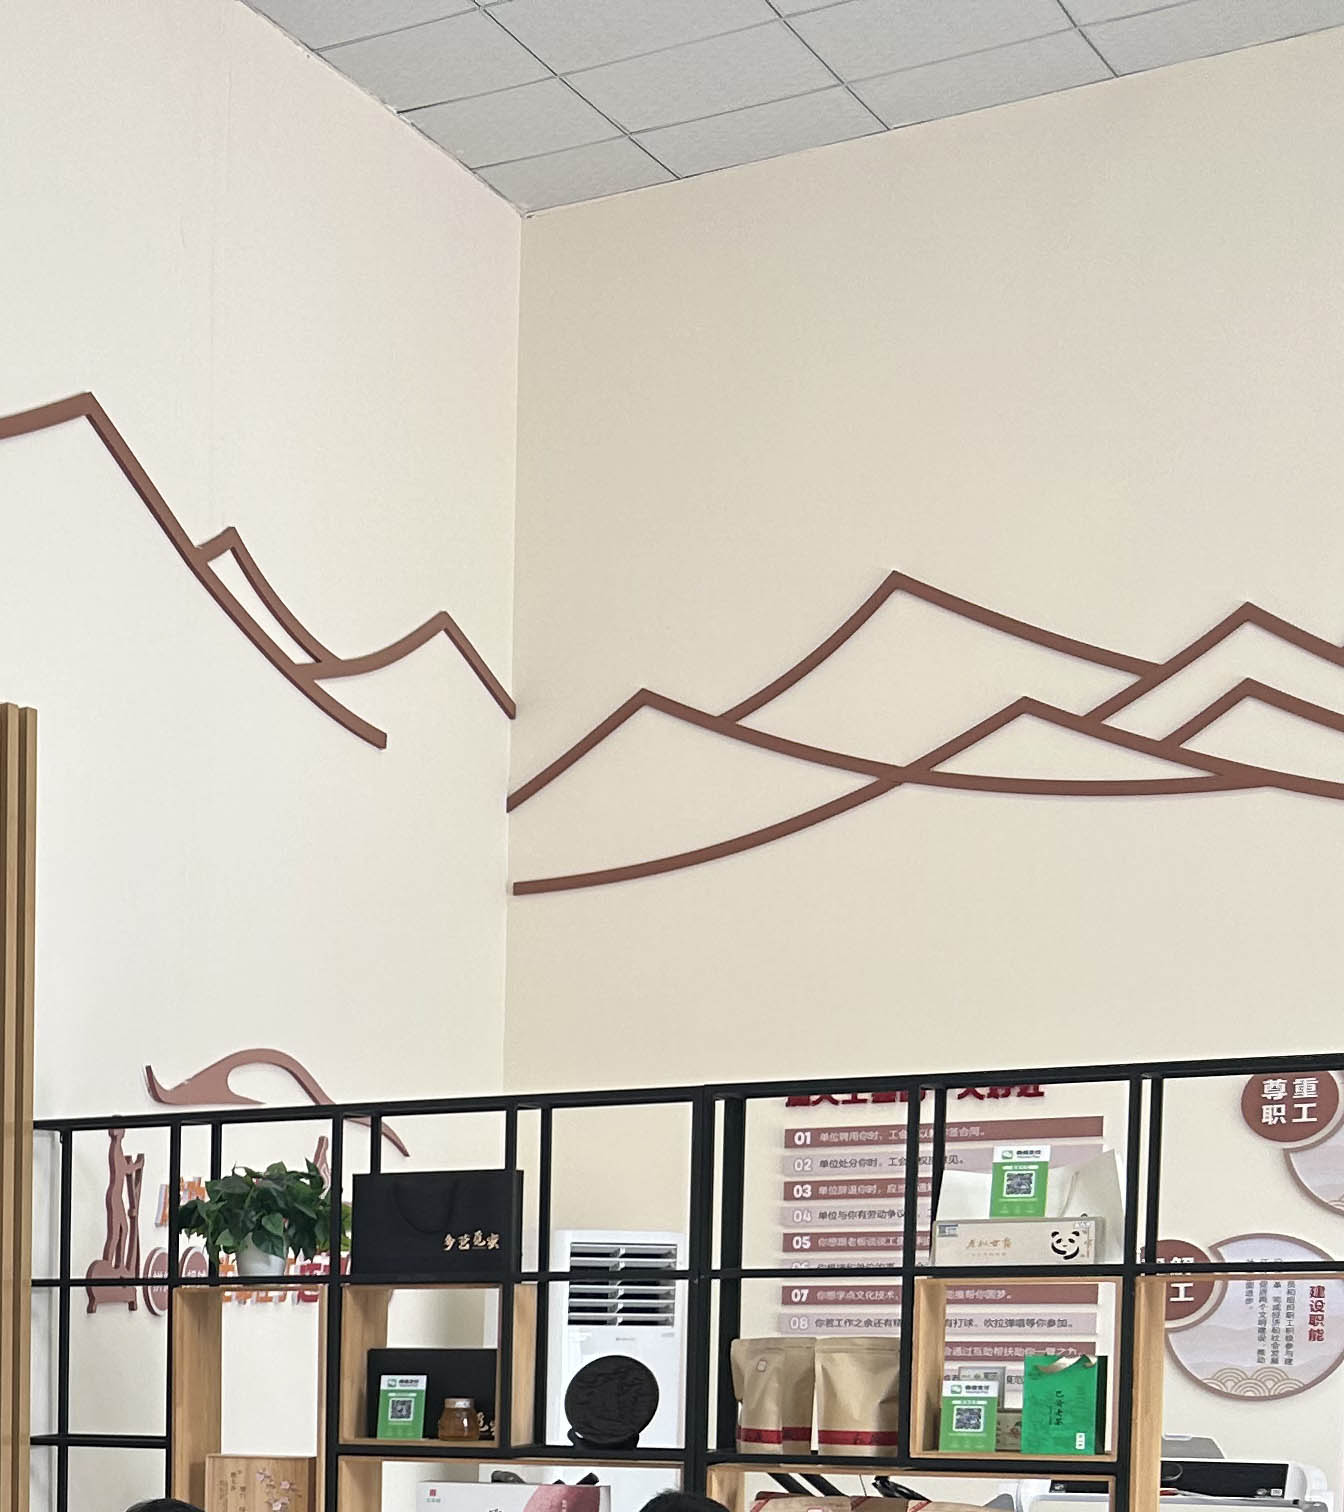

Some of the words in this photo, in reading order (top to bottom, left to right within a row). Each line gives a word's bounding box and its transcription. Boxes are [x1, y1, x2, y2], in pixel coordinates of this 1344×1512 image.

[1261, 1078, 1320, 1100] 尊重
[1261, 1102, 1319, 1126] 职工
[794, 1131, 811, 1145] 01
[794, 1158, 812, 1171] 02
[793, 1184, 812, 1198] 03
[793, 1210, 812, 1223] 04
[792, 1236, 811, 1249] 05
[791, 1288, 810, 1302] 07
[1308, 1285, 1325, 1341] 建设职能
[790, 1316, 809, 1329] 08
